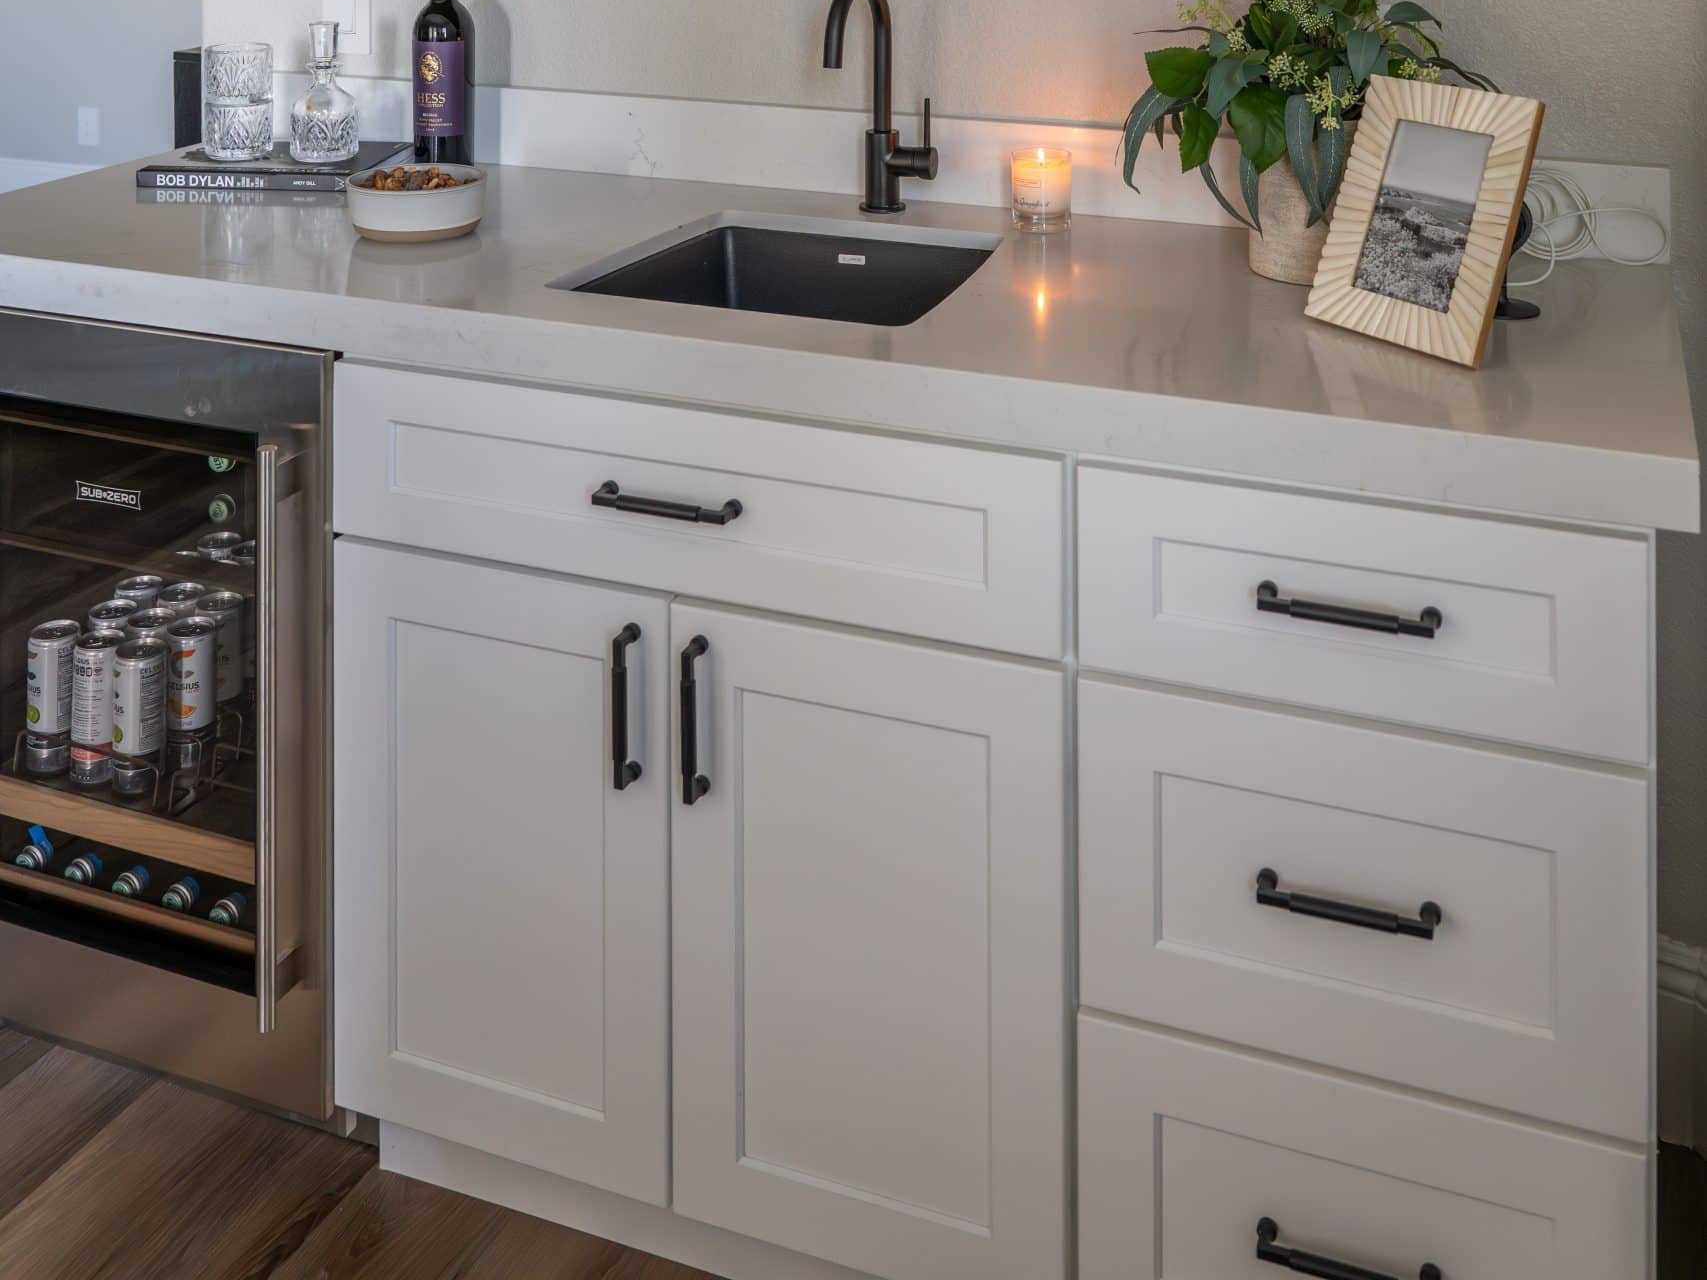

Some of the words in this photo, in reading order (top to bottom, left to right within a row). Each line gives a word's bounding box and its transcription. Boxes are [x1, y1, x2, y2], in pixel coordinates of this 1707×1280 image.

[417, 92, 446, 104] HESS
[156, 174, 185, 187] BOB
[189, 175, 234, 188] DYLAN
